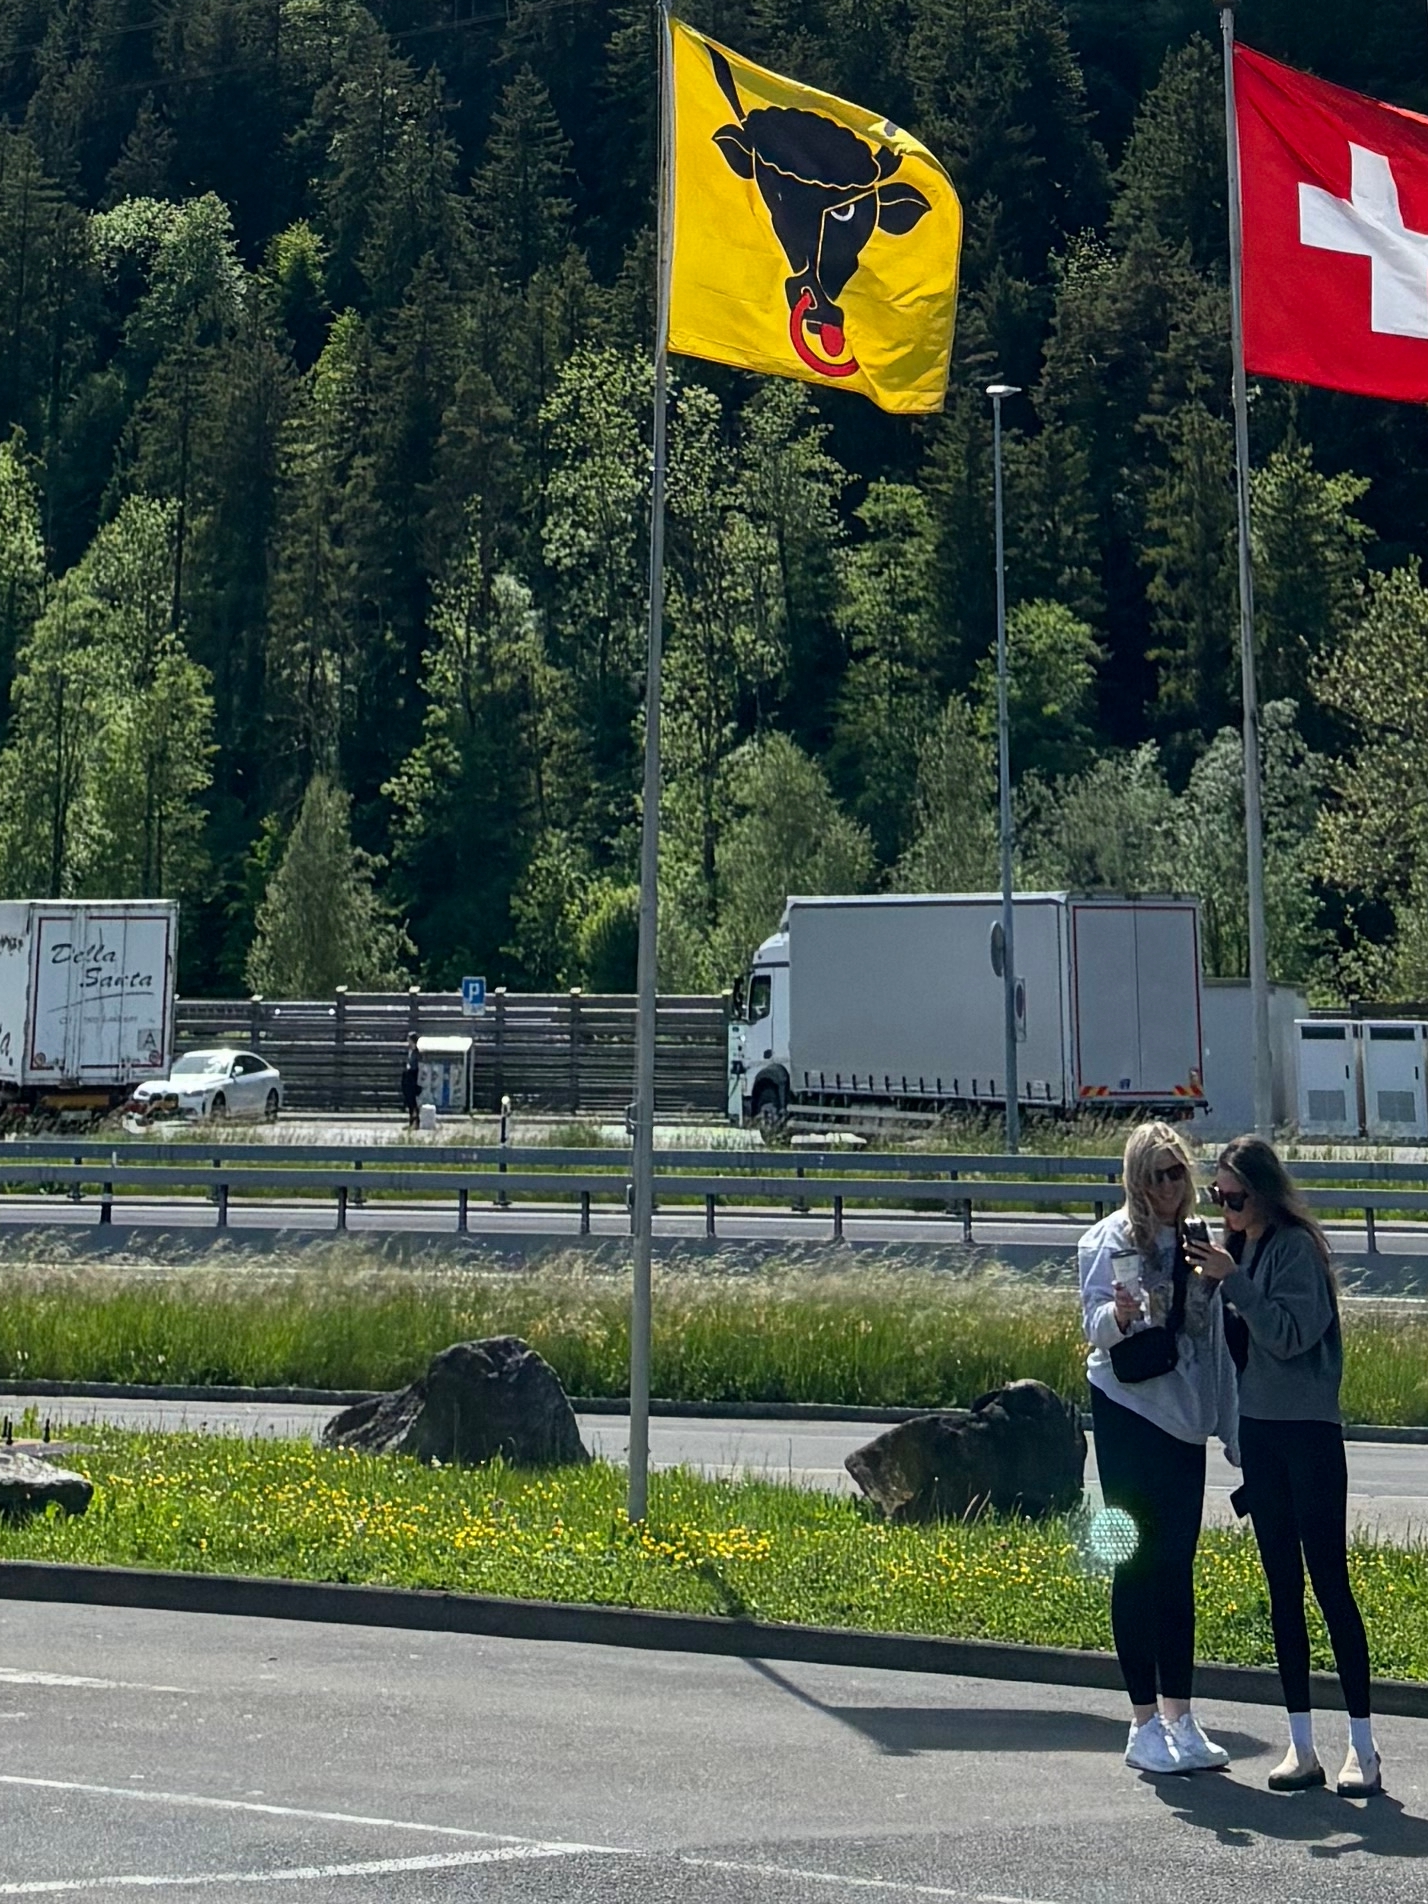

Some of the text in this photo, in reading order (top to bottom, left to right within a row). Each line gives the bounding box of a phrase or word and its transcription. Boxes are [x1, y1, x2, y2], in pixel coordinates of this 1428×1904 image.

[50, 943, 116, 964] Della
[79, 967, 153, 988] Santa
[468, 982, 480, 1002] P
[143, 1032, 157, 1048] A
